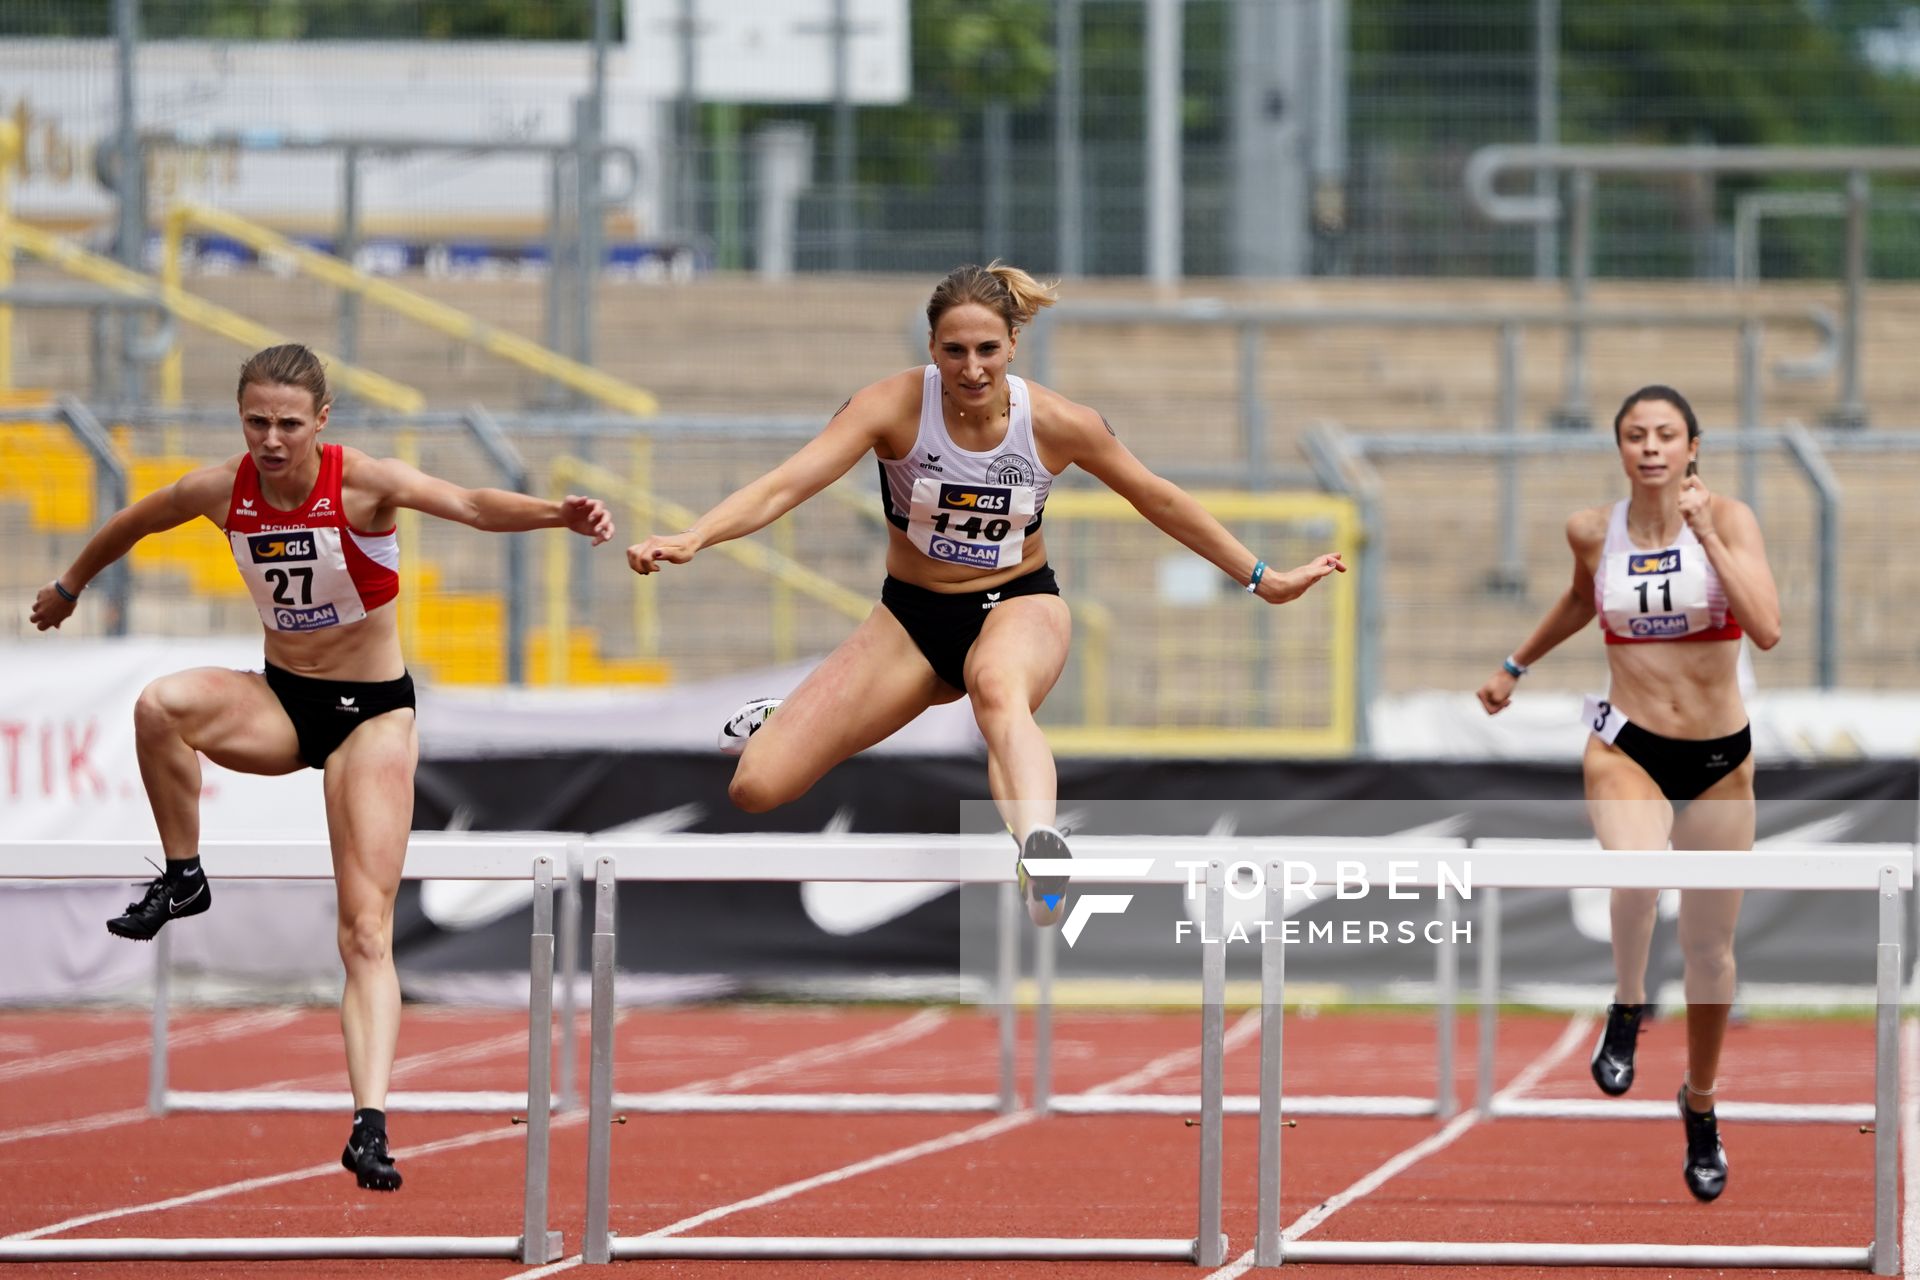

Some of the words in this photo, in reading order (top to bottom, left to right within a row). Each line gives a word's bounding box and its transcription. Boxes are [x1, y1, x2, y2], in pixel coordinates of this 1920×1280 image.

[919, 462, 943, 473] erima
[976, 494, 1005, 510] GLS
[931, 512, 1011, 541] 140
[285, 540, 310, 556] GLS
[958, 545, 997, 560] PLAN
[265, 567, 313, 605] 27
[1634, 579, 1672, 613] 11
[296, 607, 334, 623] PLAN
[1593, 701, 1611, 731] 3
